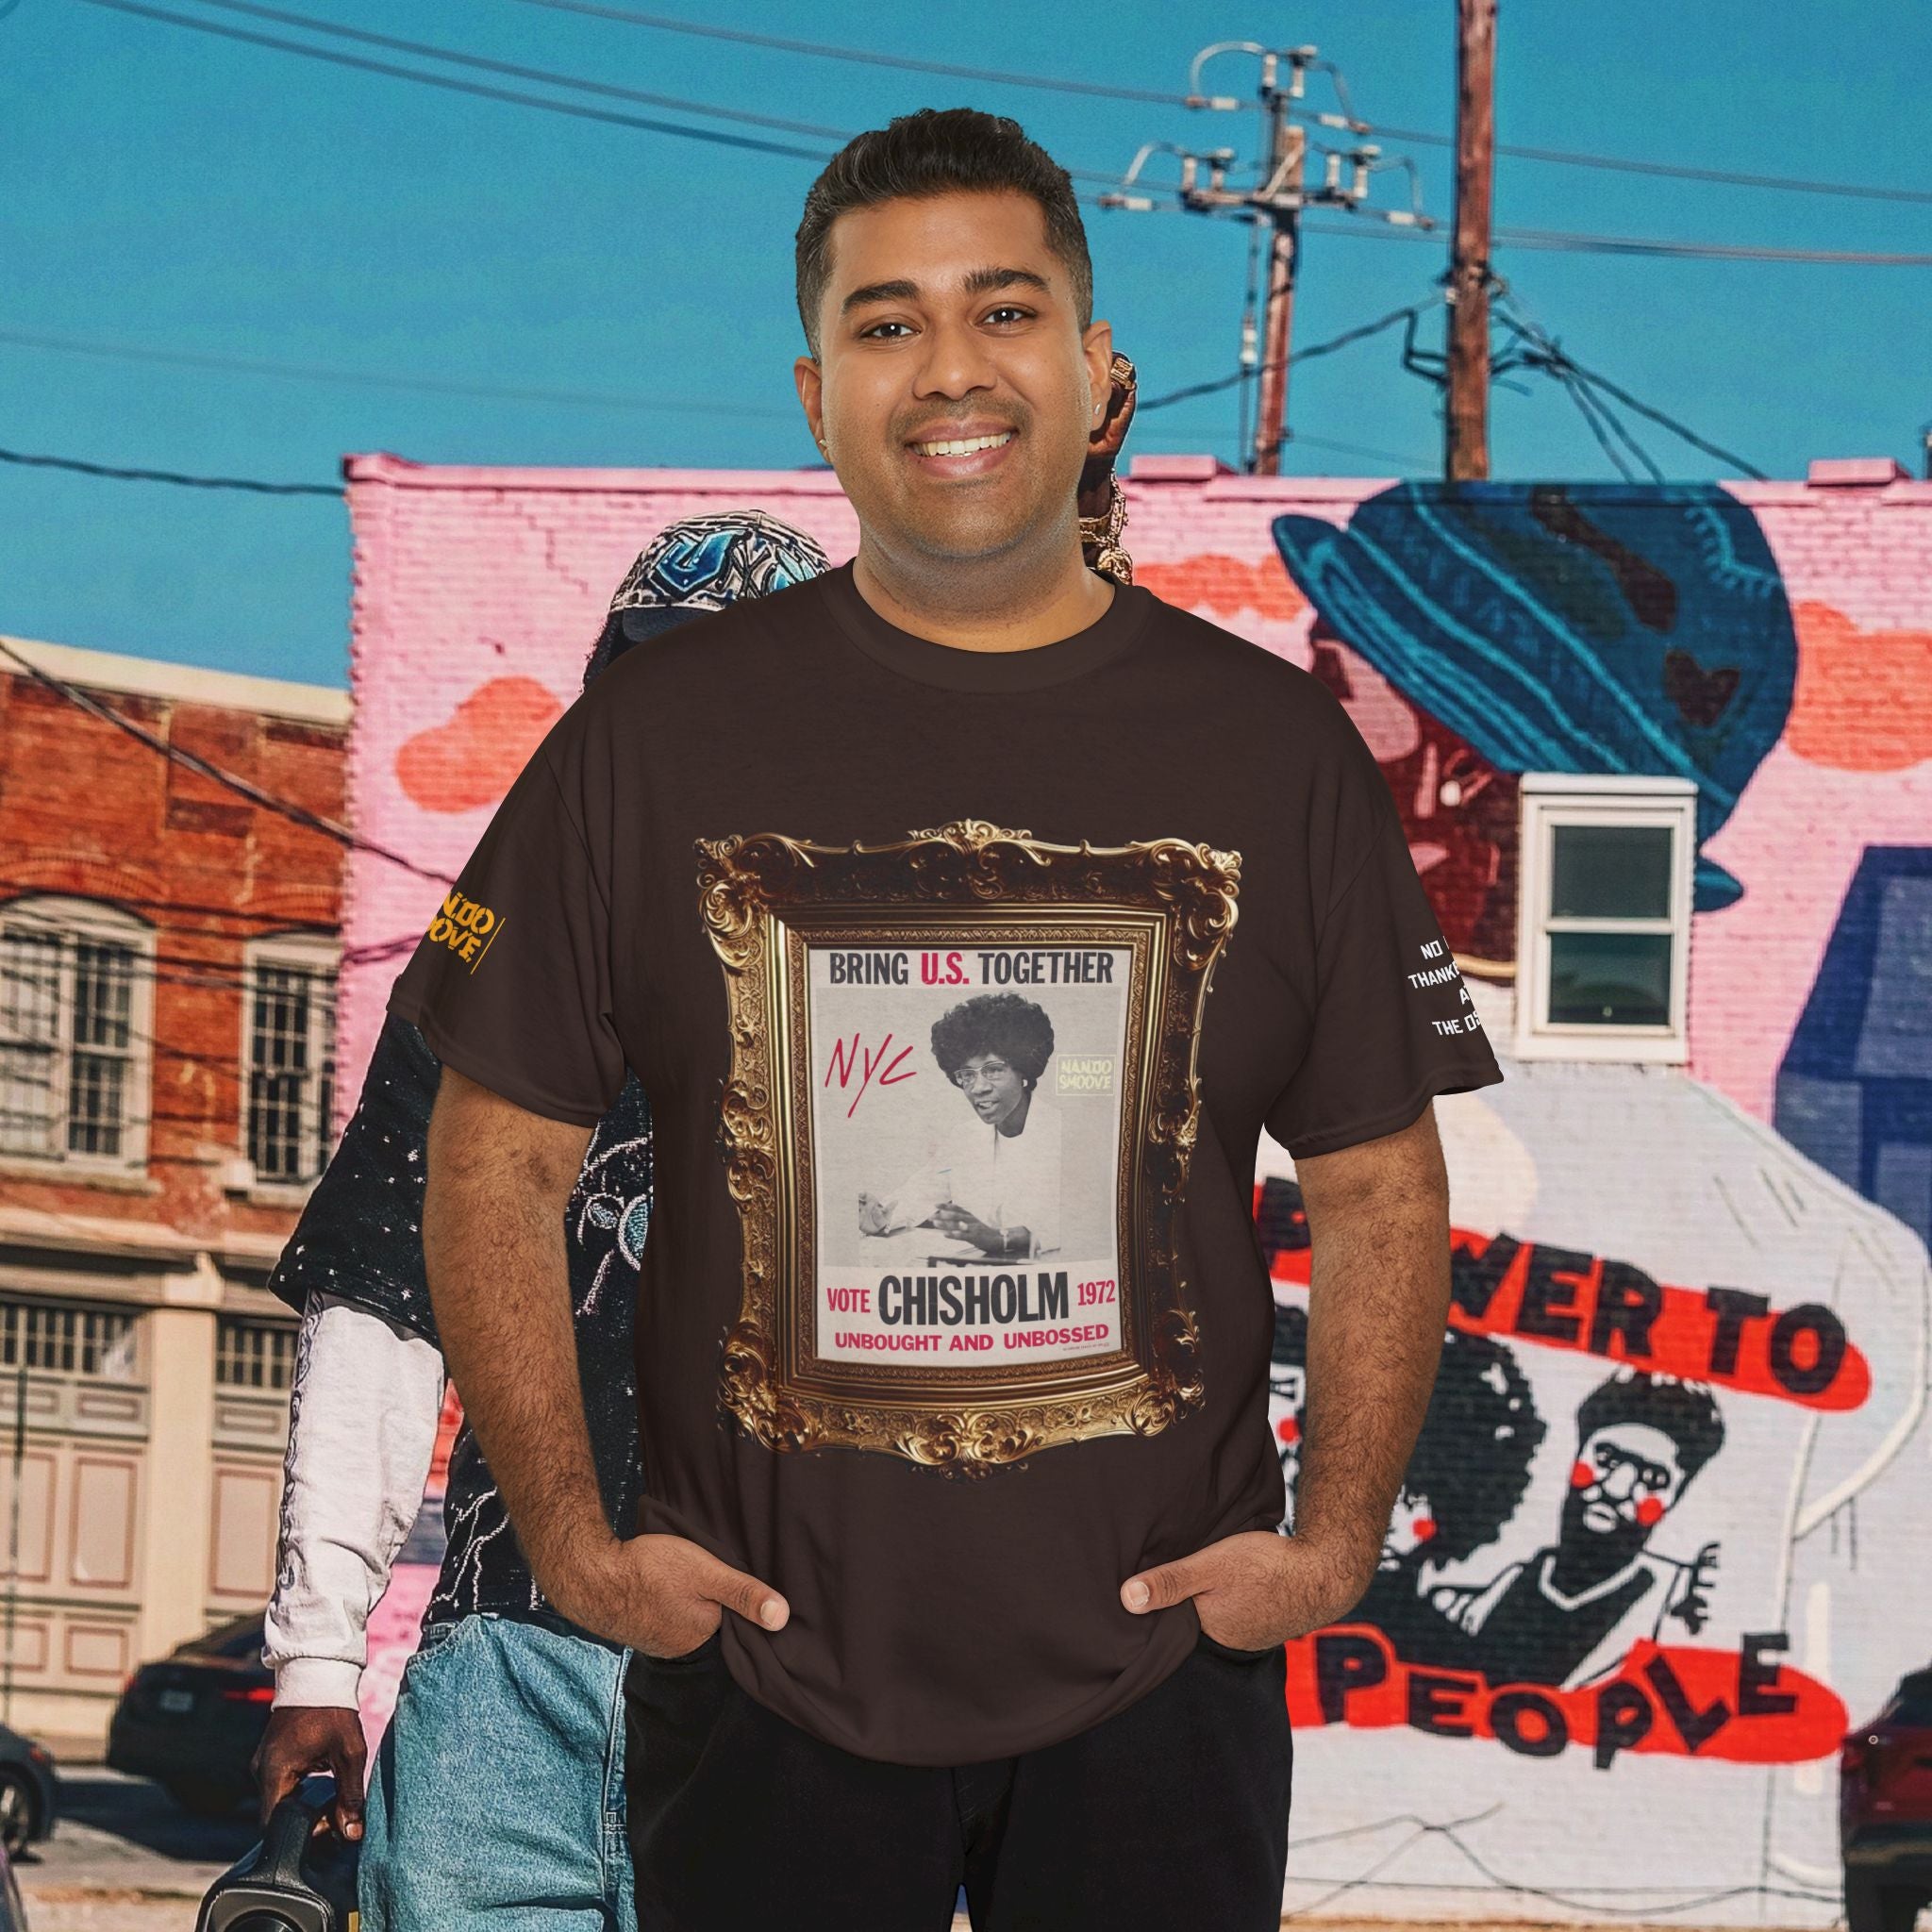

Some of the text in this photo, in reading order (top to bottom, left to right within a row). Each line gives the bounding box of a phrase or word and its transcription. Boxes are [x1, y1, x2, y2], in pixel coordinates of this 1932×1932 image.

[829, 952, 1114, 985] BRING U.S. TOGETHER
[1420, 940, 1444, 960] NO
[1432, 1019, 1463, 1036] THE
[824, 1033, 917, 1119] NYC
[826, 1271, 1116, 1326] VOTE CHISHOLM 1972
[1257, 1176, 1847, 1394] PWER TO
[835, 1332, 942, 1353] UNBOUGHT
[949, 1334, 994, 1352] AND
[1004, 1324, 1110, 1350] UNBOSSED
[1314, 1633, 1798, 1771] PEOPLE
